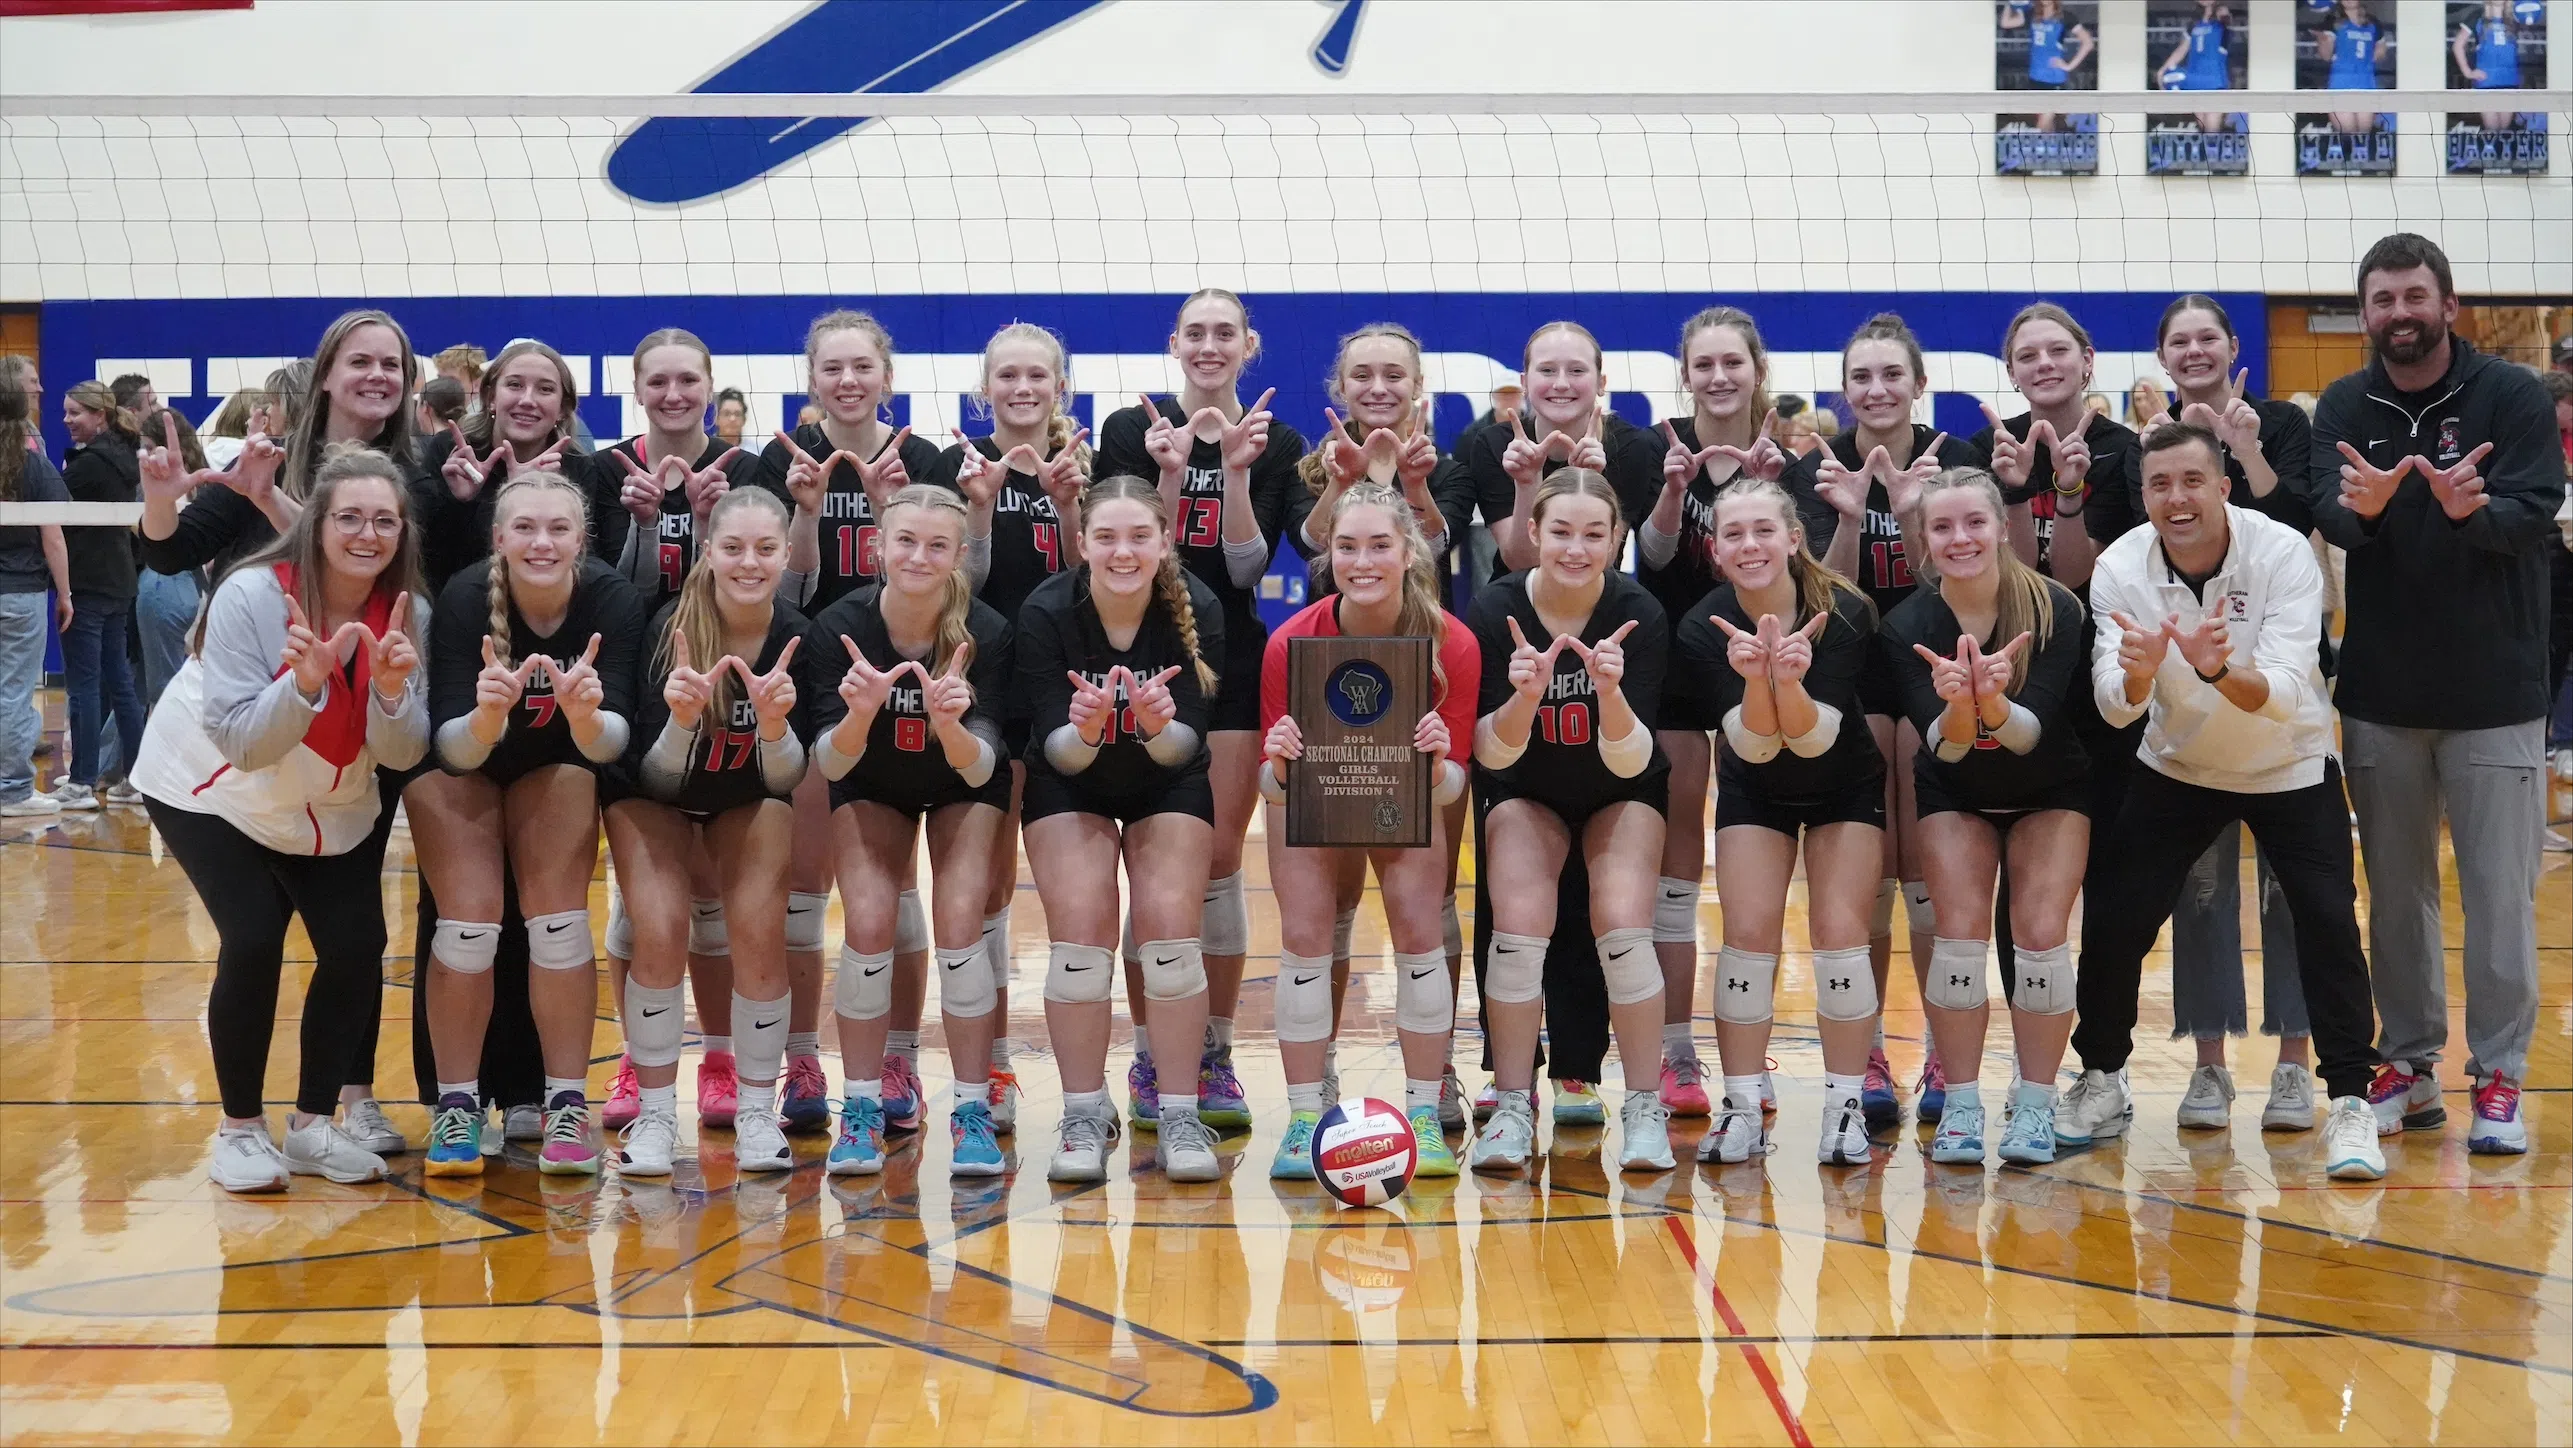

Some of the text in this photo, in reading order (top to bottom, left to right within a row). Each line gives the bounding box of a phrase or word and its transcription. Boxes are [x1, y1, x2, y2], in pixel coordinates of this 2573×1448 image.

[2447, 130, 2547, 161] BAXTER
[996, 486, 1059, 519] LUTHER
[1176, 496, 1222, 548] 13
[837, 525, 879, 577] 16
[1032, 522, 1059, 573] 4
[1871, 540, 1916, 589] 12
[525, 694, 557, 729] 7
[1538, 702, 1591, 746] 10
[705, 727, 756, 772] 17
[895, 717, 926, 752] 8
[1343, 735, 1374, 743] 2024
[1306, 746, 1411, 763] SECTIONAL CHAMPION
[1339, 765, 1378, 774] GIRLS
[1318, 776, 1400, 785] VOLLEYBALL
[1323, 787, 1394, 796] DIVISION 4
[1332, 1120, 1388, 1141] Super Touch
[1334, 1137, 1395, 1164] molten
